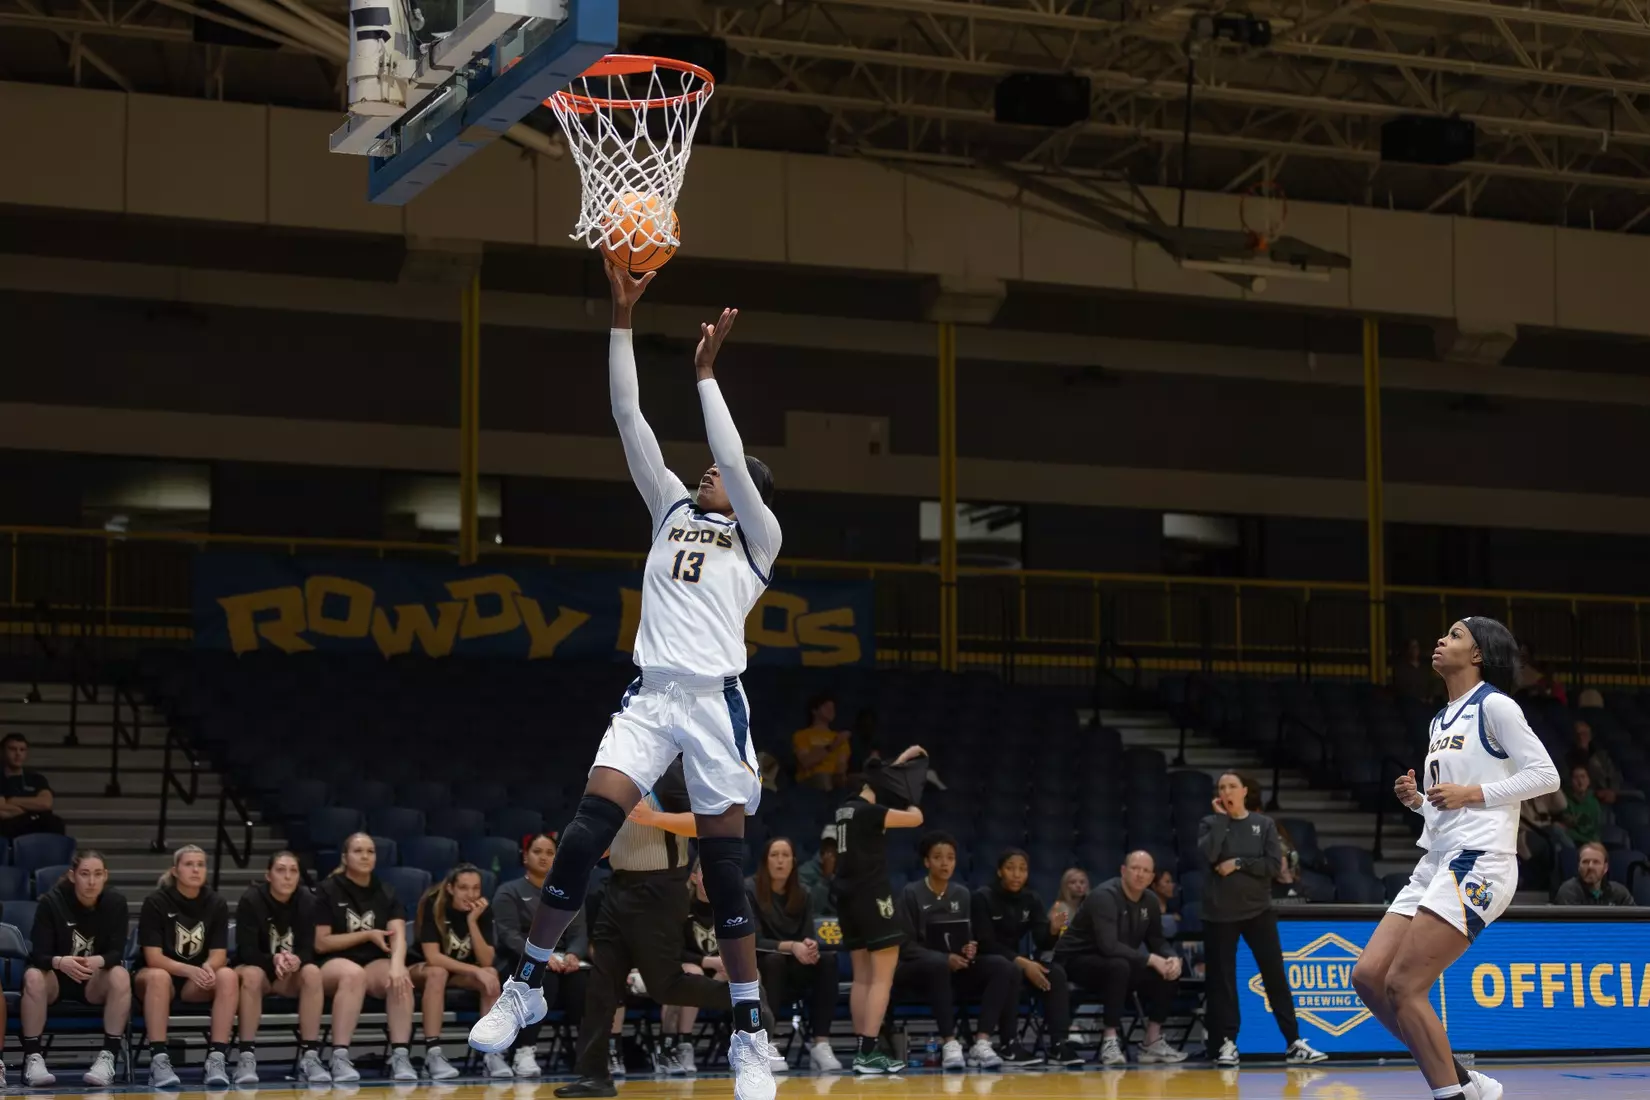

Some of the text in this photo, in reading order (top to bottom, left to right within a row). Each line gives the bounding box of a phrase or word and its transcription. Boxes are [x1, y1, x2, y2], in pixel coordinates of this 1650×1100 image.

[668, 526, 734, 549] ROOS
[671, 550, 705, 583] 13
[215, 574, 862, 669] ROWDY OS
[1429, 734, 1465, 755] OOS
[1288, 964, 1355, 990] OULEV
[1298, 996, 1352, 1007] BREWING
